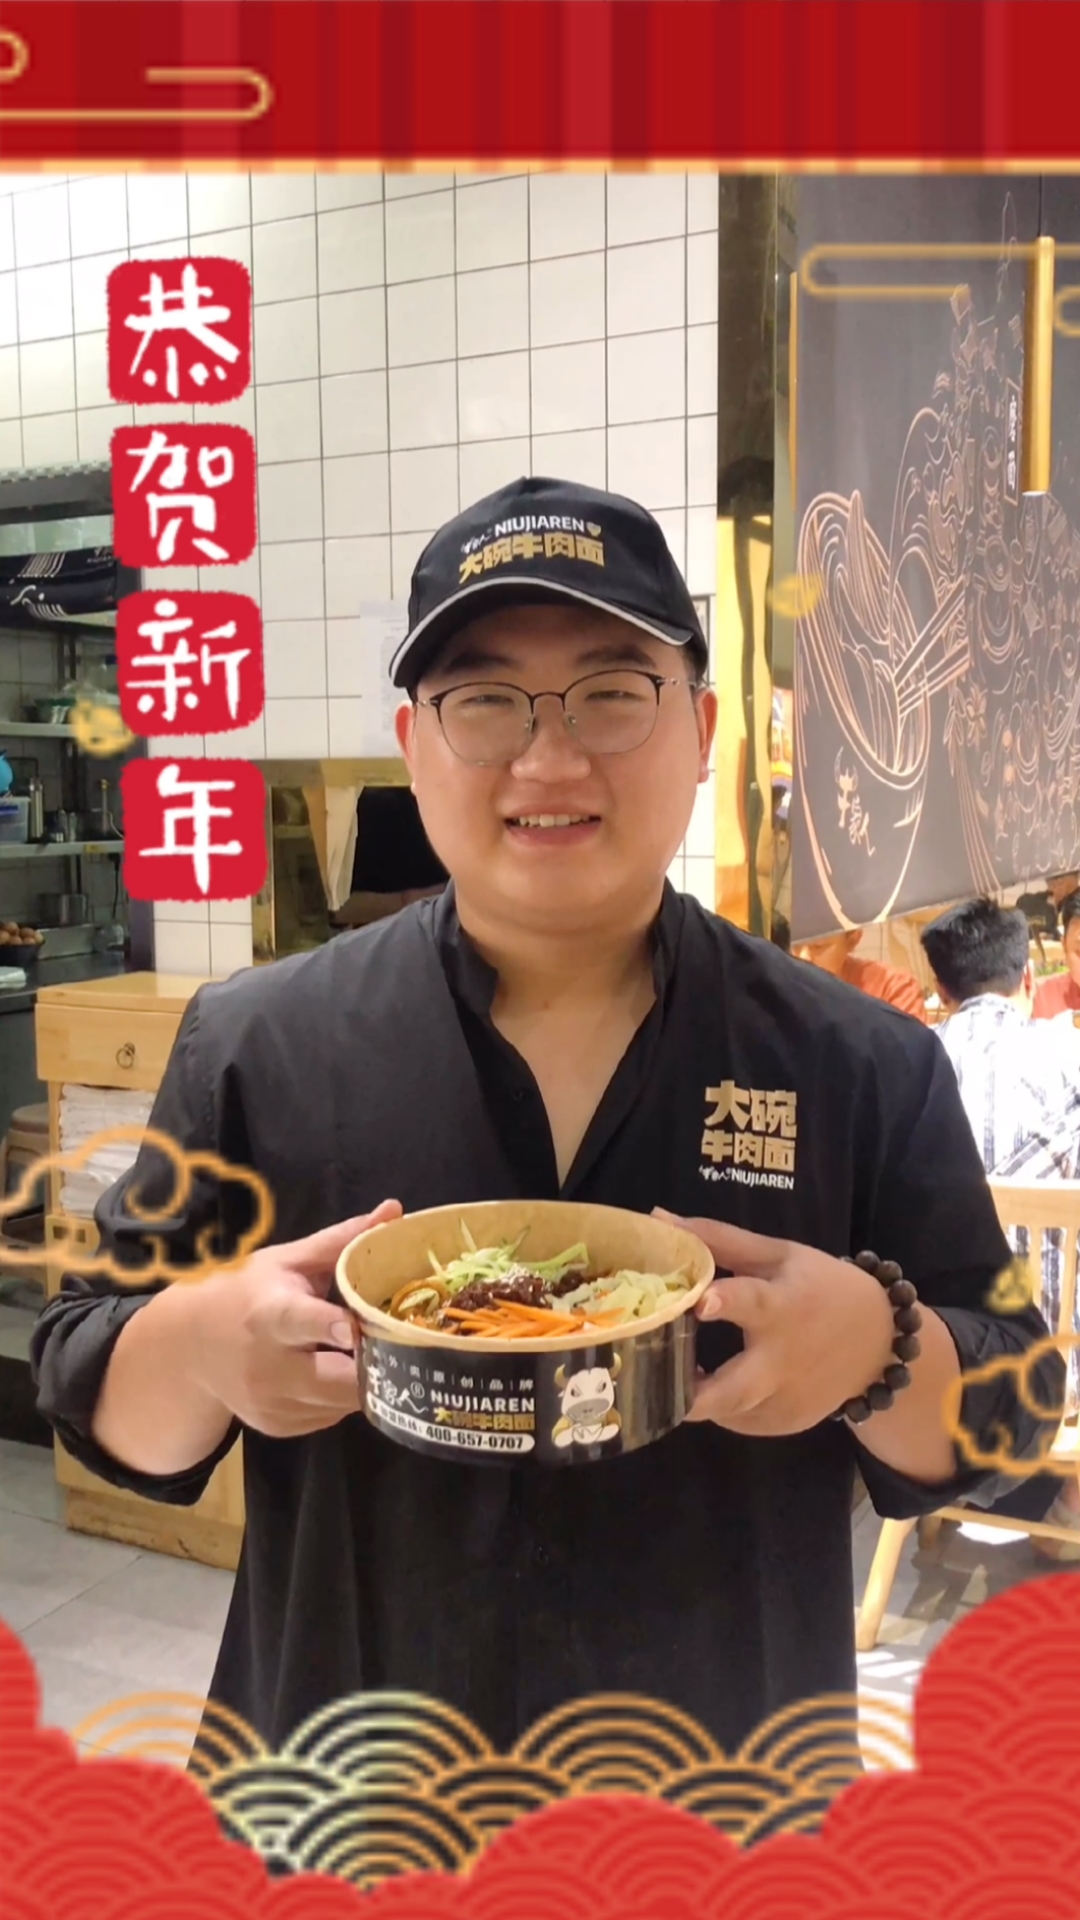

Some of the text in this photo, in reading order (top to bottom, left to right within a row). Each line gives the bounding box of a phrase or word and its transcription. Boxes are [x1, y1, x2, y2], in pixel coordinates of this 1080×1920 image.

[495, 515, 585, 537] NIUJIAREN
[459, 531, 604, 584] 大碗牛肉面
[704, 1080, 797, 1138] 大碗
[701, 1128, 795, 1172] 牛肉面
[731, 1167, 795, 1190] NIUJIAREN
[430, 1389, 535, 1412] NIUJIAREN
[433, 1407, 535, 1430] 大碗牛肉面
[426, 1425, 523, 1450] 400-657-0707
